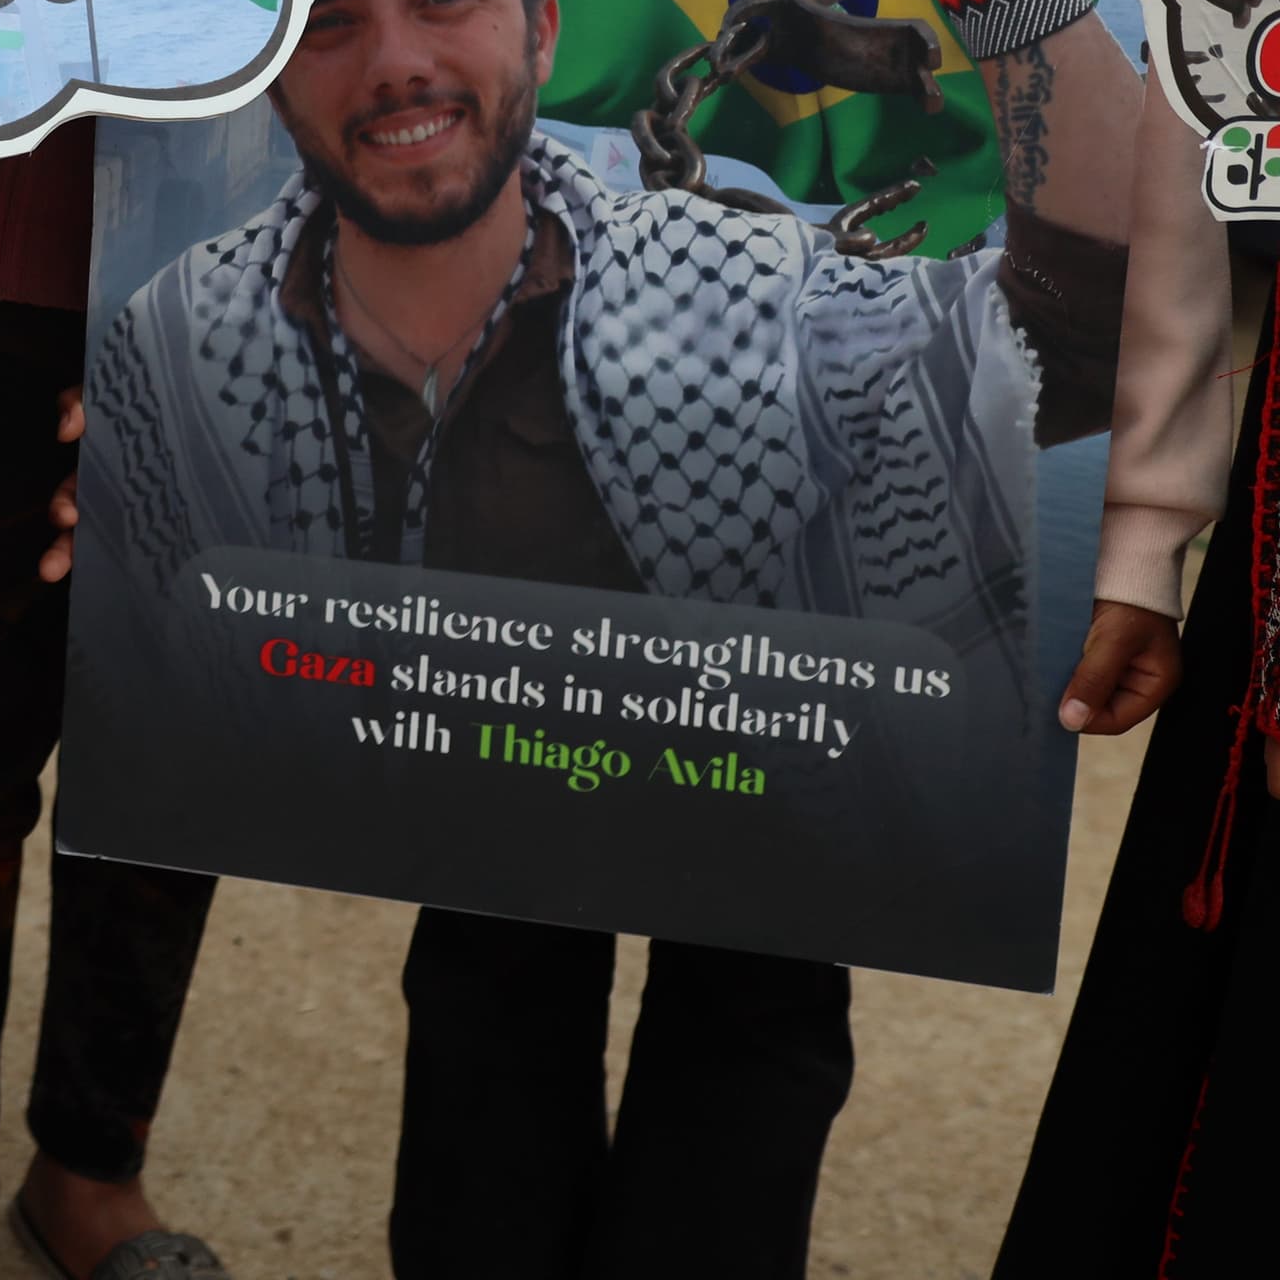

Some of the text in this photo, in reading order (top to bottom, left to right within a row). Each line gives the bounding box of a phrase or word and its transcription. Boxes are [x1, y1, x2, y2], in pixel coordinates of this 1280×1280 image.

[200, 572, 952, 699] Your resilience strengthens us
[258, 637, 861, 759] Gaza stands in solidarity
[351, 710, 766, 796] with Thiago Avila
